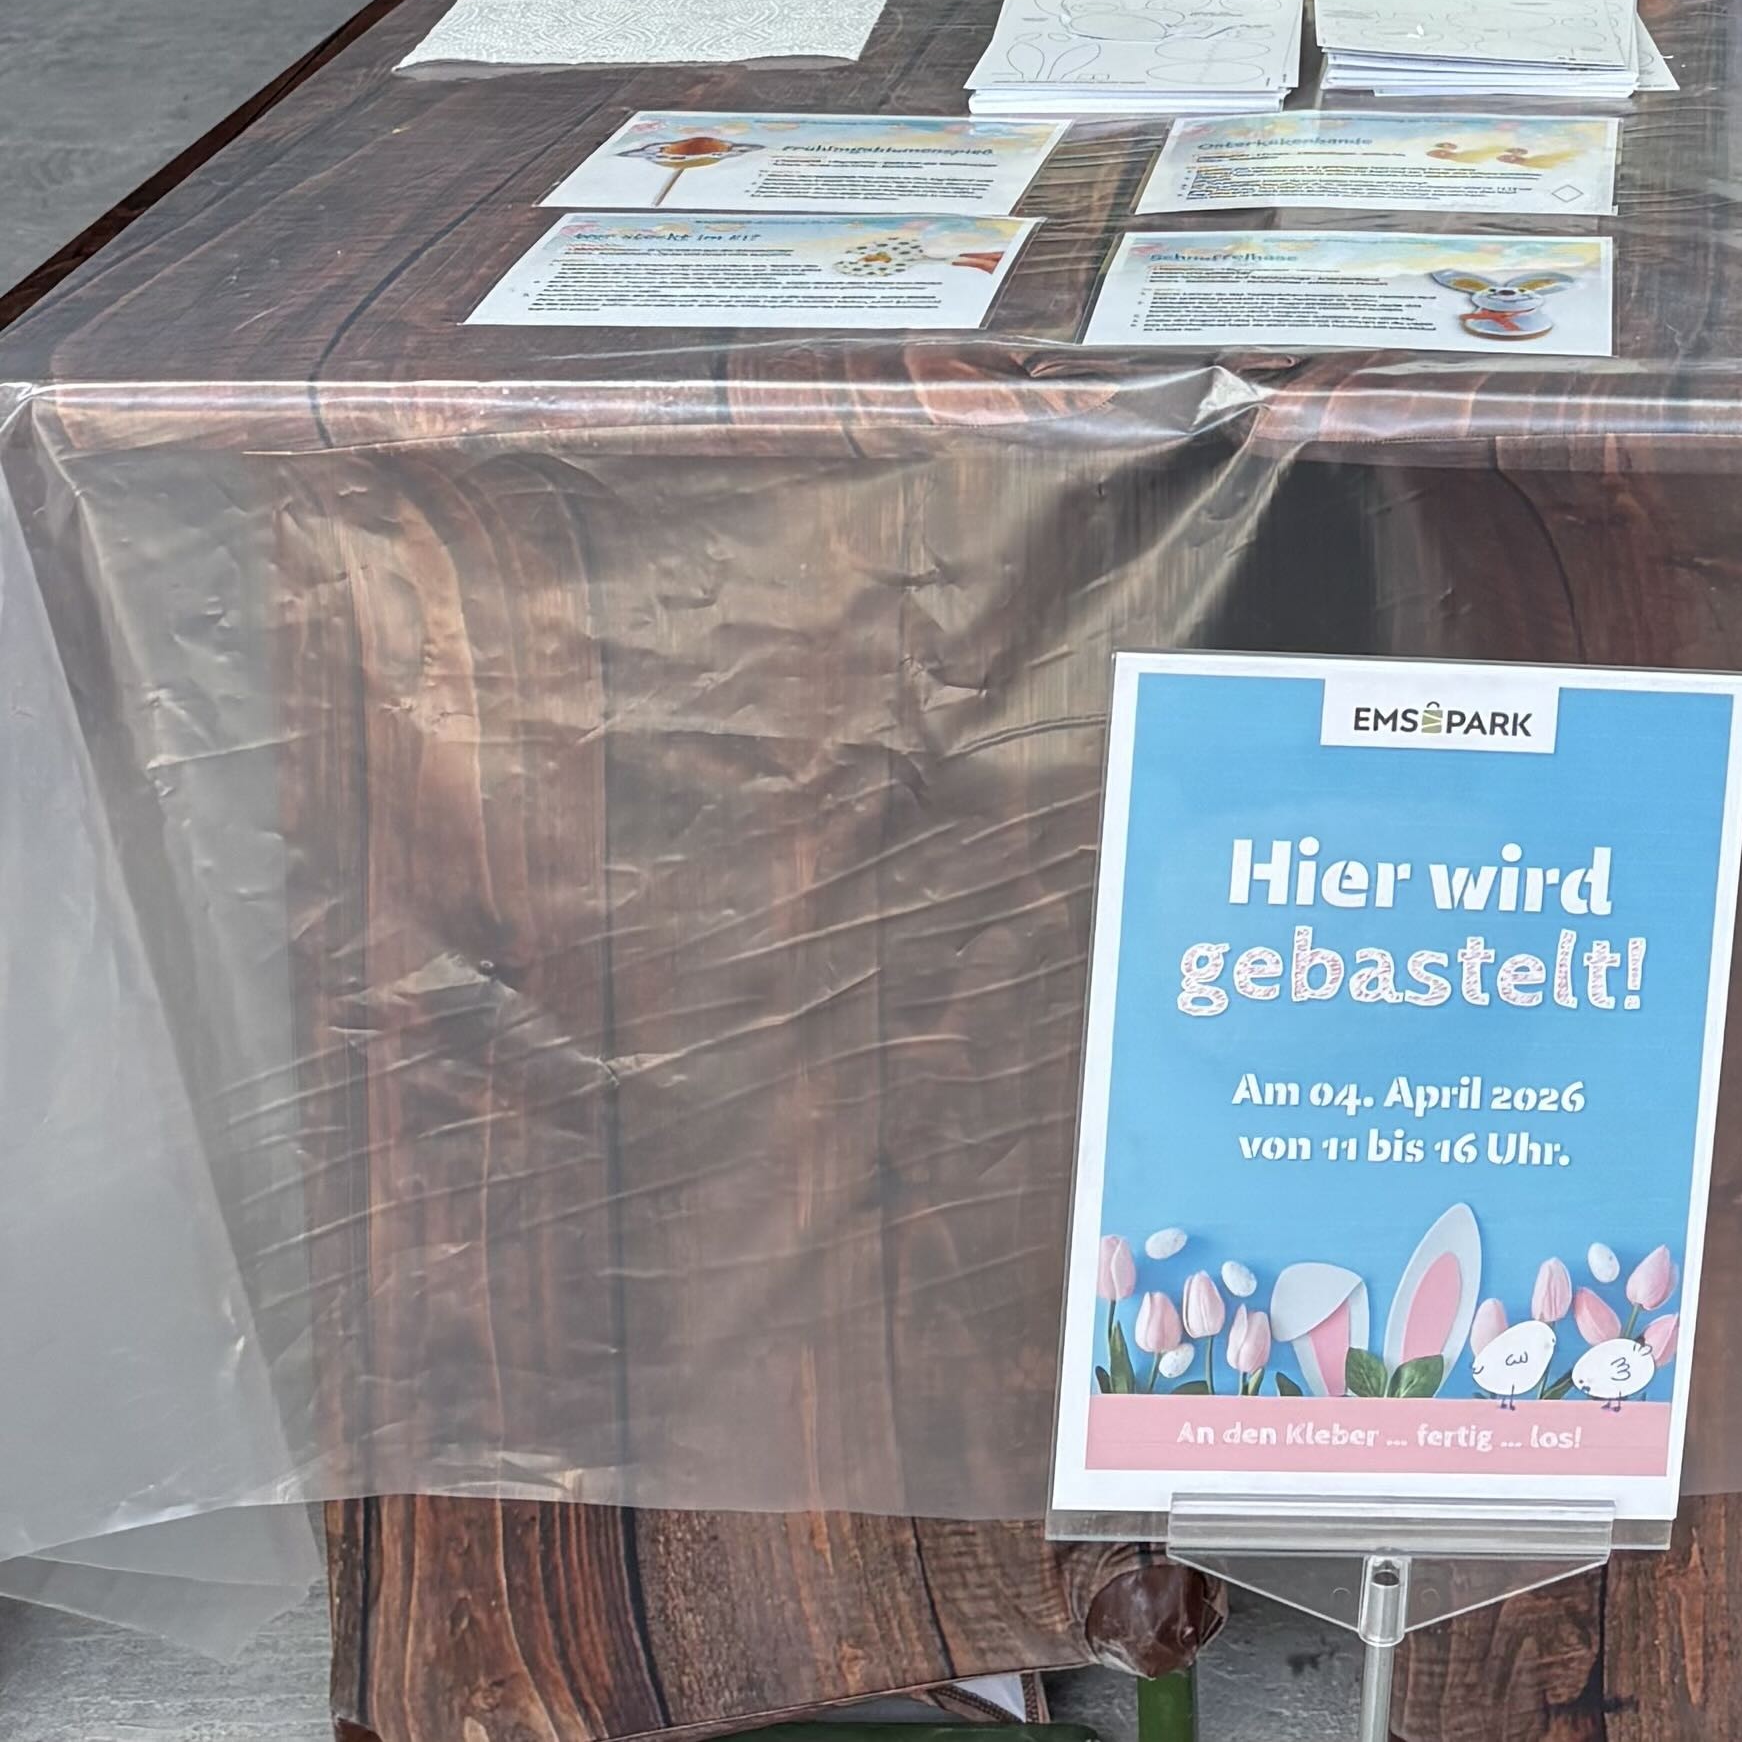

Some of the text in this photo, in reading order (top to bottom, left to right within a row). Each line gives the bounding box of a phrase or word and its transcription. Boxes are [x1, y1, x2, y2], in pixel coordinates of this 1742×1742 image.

[1228, 836, 1613, 915] Hier wird
[1177, 925, 1647, 1016] gebastelt!
[1231, 1073, 1585, 1117] Am 04. April 2026
[1238, 1128, 1571, 1166] von 11 bis 16 Uhr.
[1176, 1421, 1215, 1445] An
[1222, 1421, 1277, 1446] den
[1285, 1422, 1380, 1447] Kleber
[1417, 1423, 1494, 1453] fertig
[1530, 1425, 1582, 1449] los!
